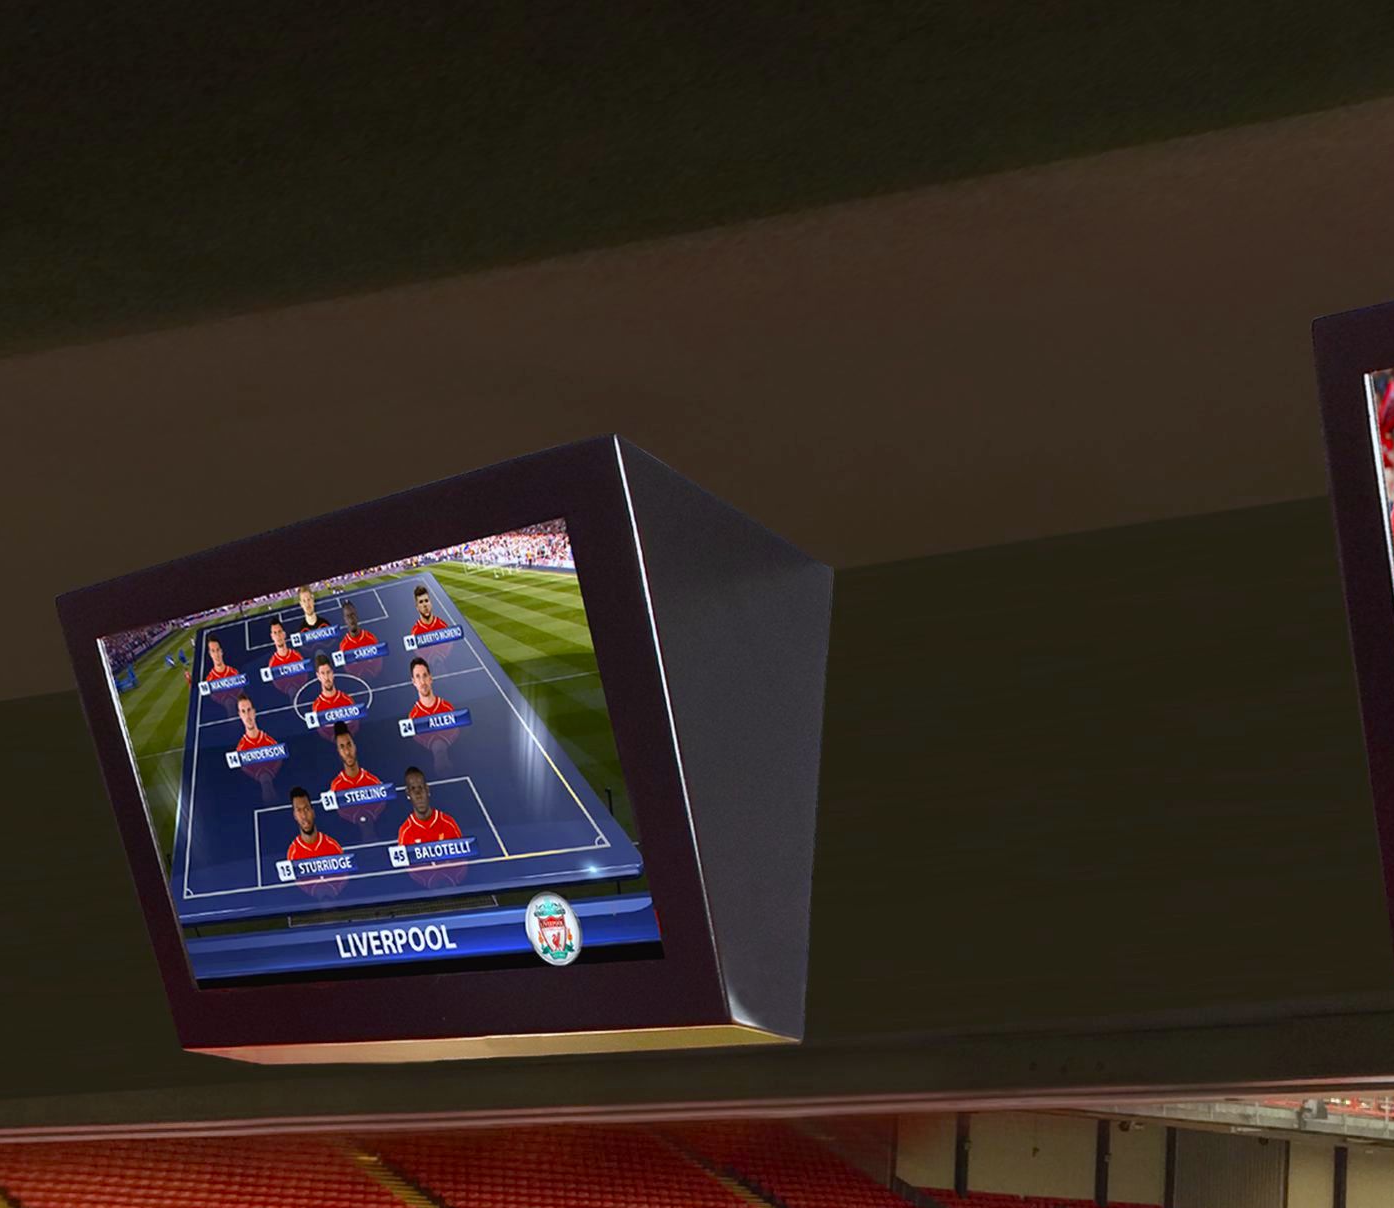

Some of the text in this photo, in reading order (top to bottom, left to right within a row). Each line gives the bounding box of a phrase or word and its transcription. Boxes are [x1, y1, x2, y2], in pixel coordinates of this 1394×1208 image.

[354, 646, 378, 660] SAKHO
[324, 706, 360, 722] GERRARD
[401, 714, 456, 735] 24 ALLEN
[240, 744, 286, 763] HENDERSON
[323, 786, 388, 806] 31 STERLING
[393, 841, 471, 863] 45 BALOTELLI
[280, 856, 353, 878] 15 STURRIDGE
[336, 924, 457, 959] LIVERPOOL
